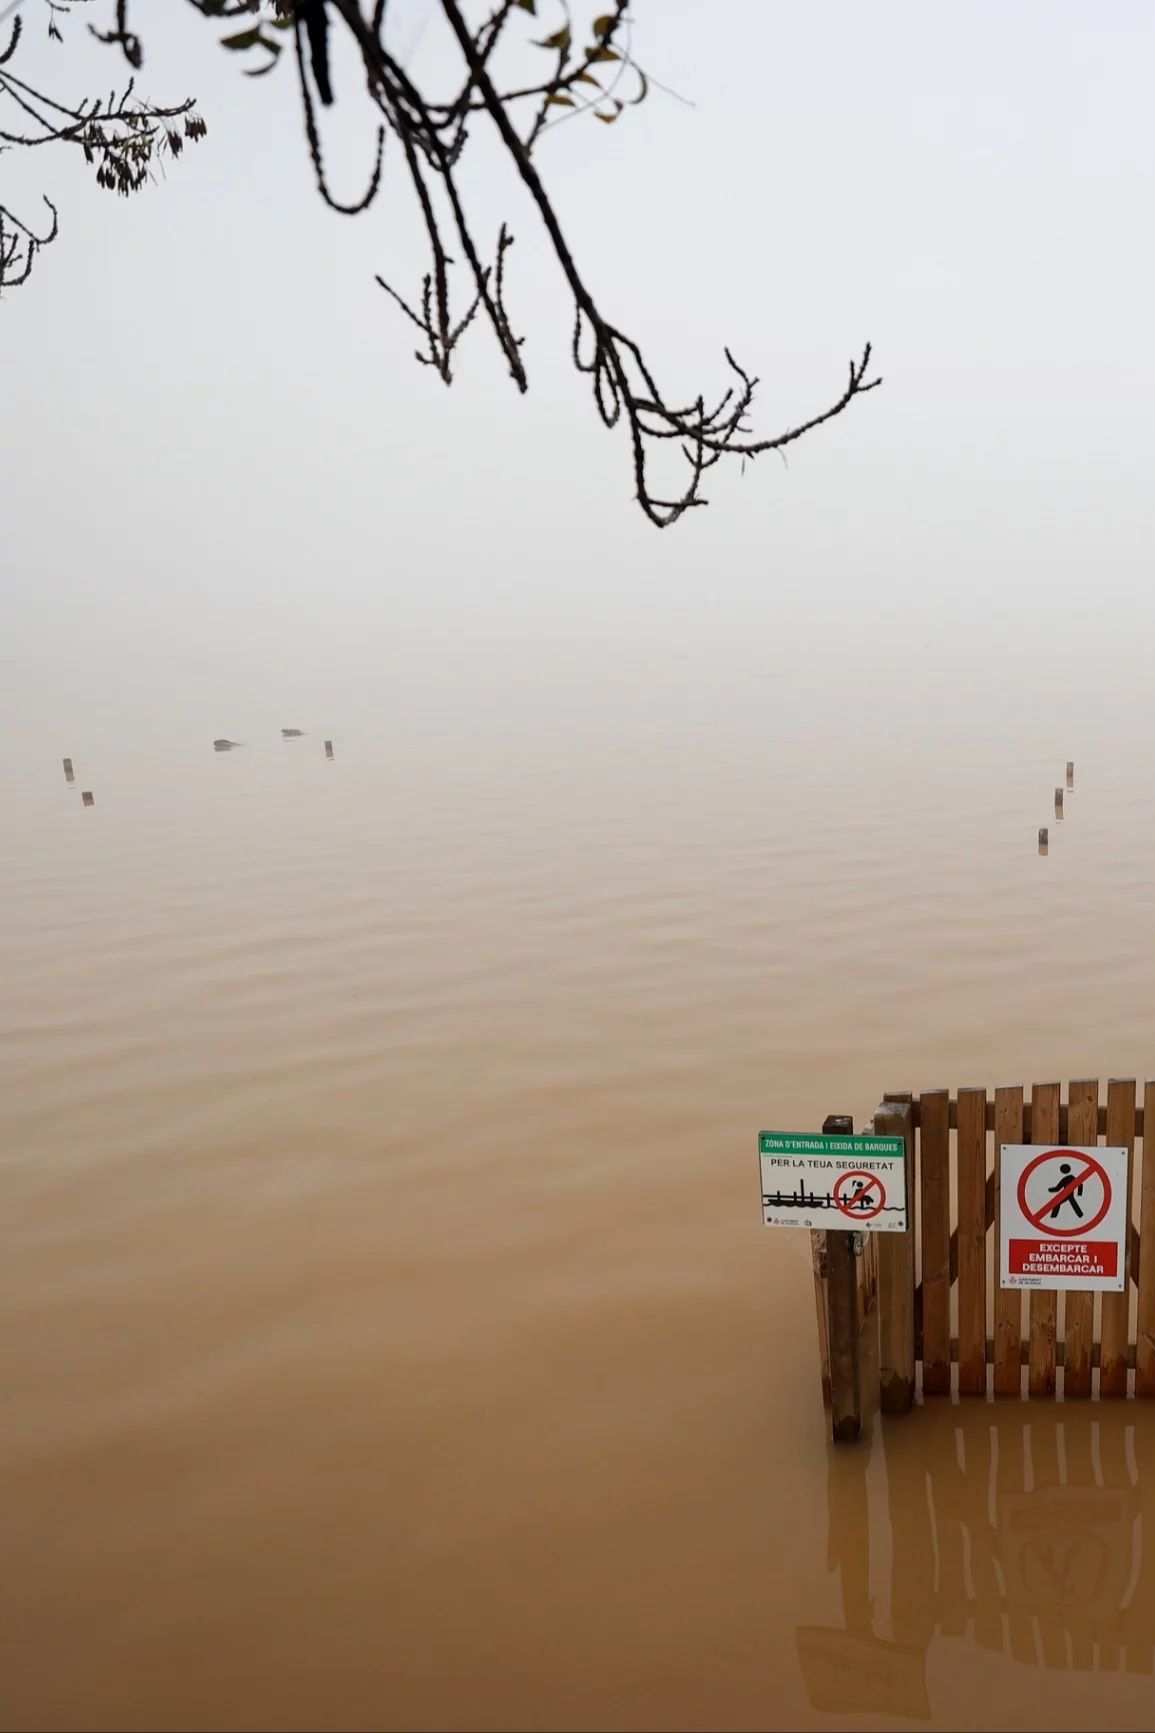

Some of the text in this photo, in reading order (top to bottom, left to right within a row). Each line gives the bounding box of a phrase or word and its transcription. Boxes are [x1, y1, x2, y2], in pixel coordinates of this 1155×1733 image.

[765, 1140, 897, 1152] ZONA D'ENTRADA I EIXIDA DE BARQUES
[771, 1159, 894, 1171] PER LA TEUA SEGURETAT
[1040, 1244, 1087, 1253] EXCEPTE
[1029, 1253, 1098, 1263] EMBARCAR I
[1022, 1263, 1104, 1274] DESEMBARCAR
